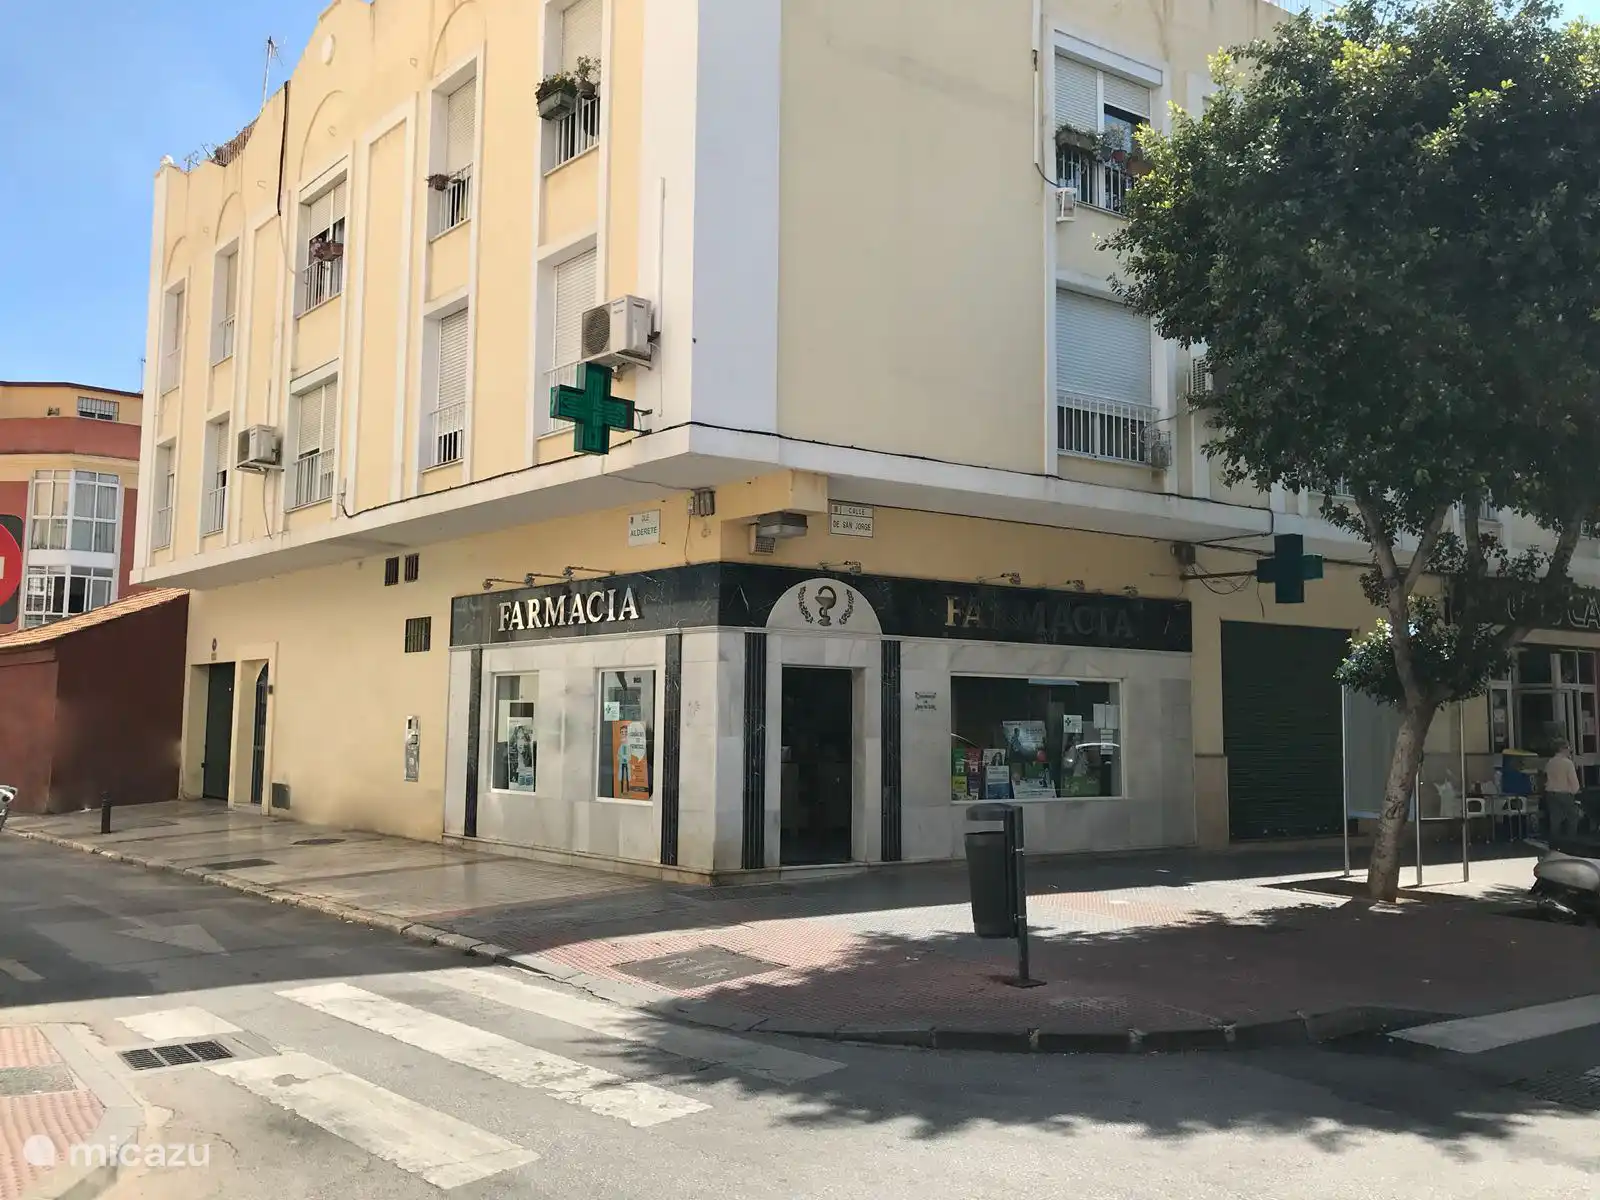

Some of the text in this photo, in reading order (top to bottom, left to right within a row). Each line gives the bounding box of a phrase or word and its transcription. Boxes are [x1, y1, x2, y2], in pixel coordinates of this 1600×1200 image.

[848, 507, 865, 515] CALLE
[833, 520, 840, 528] DE
[842, 521, 853, 529] SAN
[630, 526, 658, 537] ALDERETE
[498, 585, 640, 632] FARMACIA
